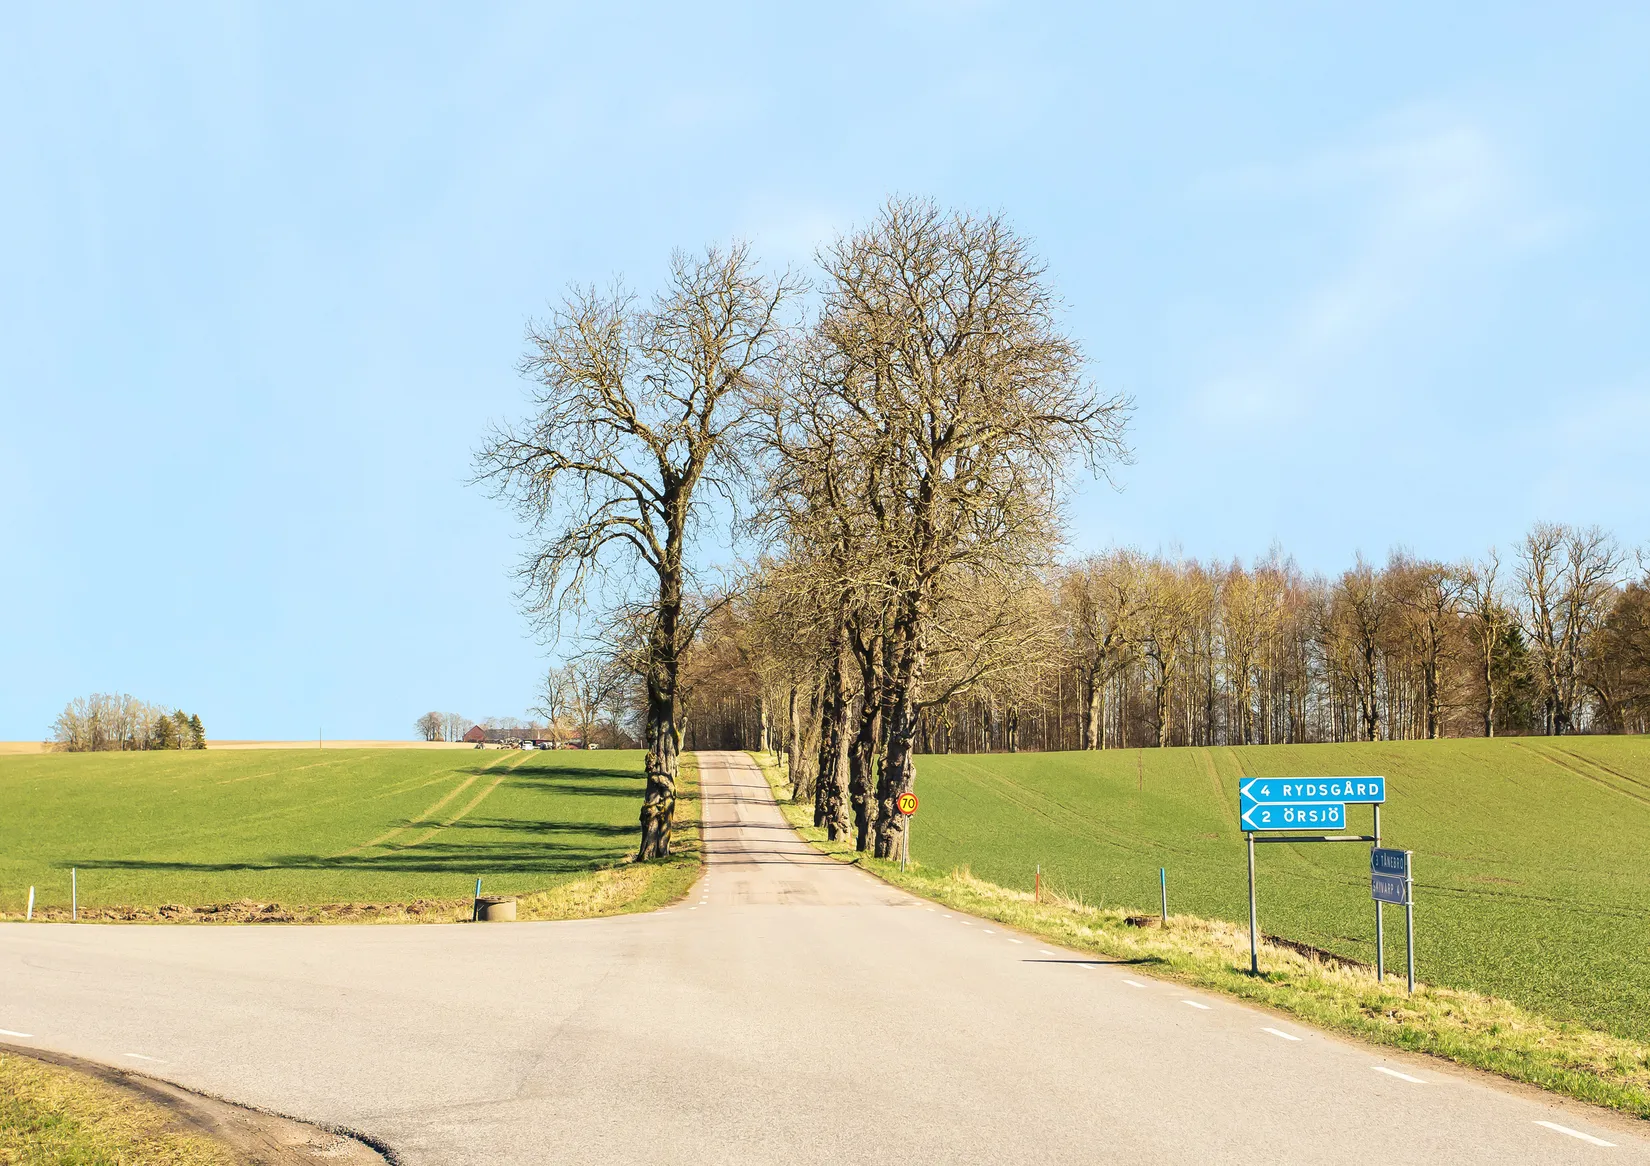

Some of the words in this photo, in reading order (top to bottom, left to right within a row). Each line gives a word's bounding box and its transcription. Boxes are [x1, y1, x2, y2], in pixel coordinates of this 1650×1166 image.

[1260, 784, 1271, 797] 4
[1283, 780, 1379, 797] RYDSGÅRD
[902, 798, 915, 808] 70
[1261, 810, 1271, 823] 2
[1283, 807, 1339, 823] ÖRSJÖ
